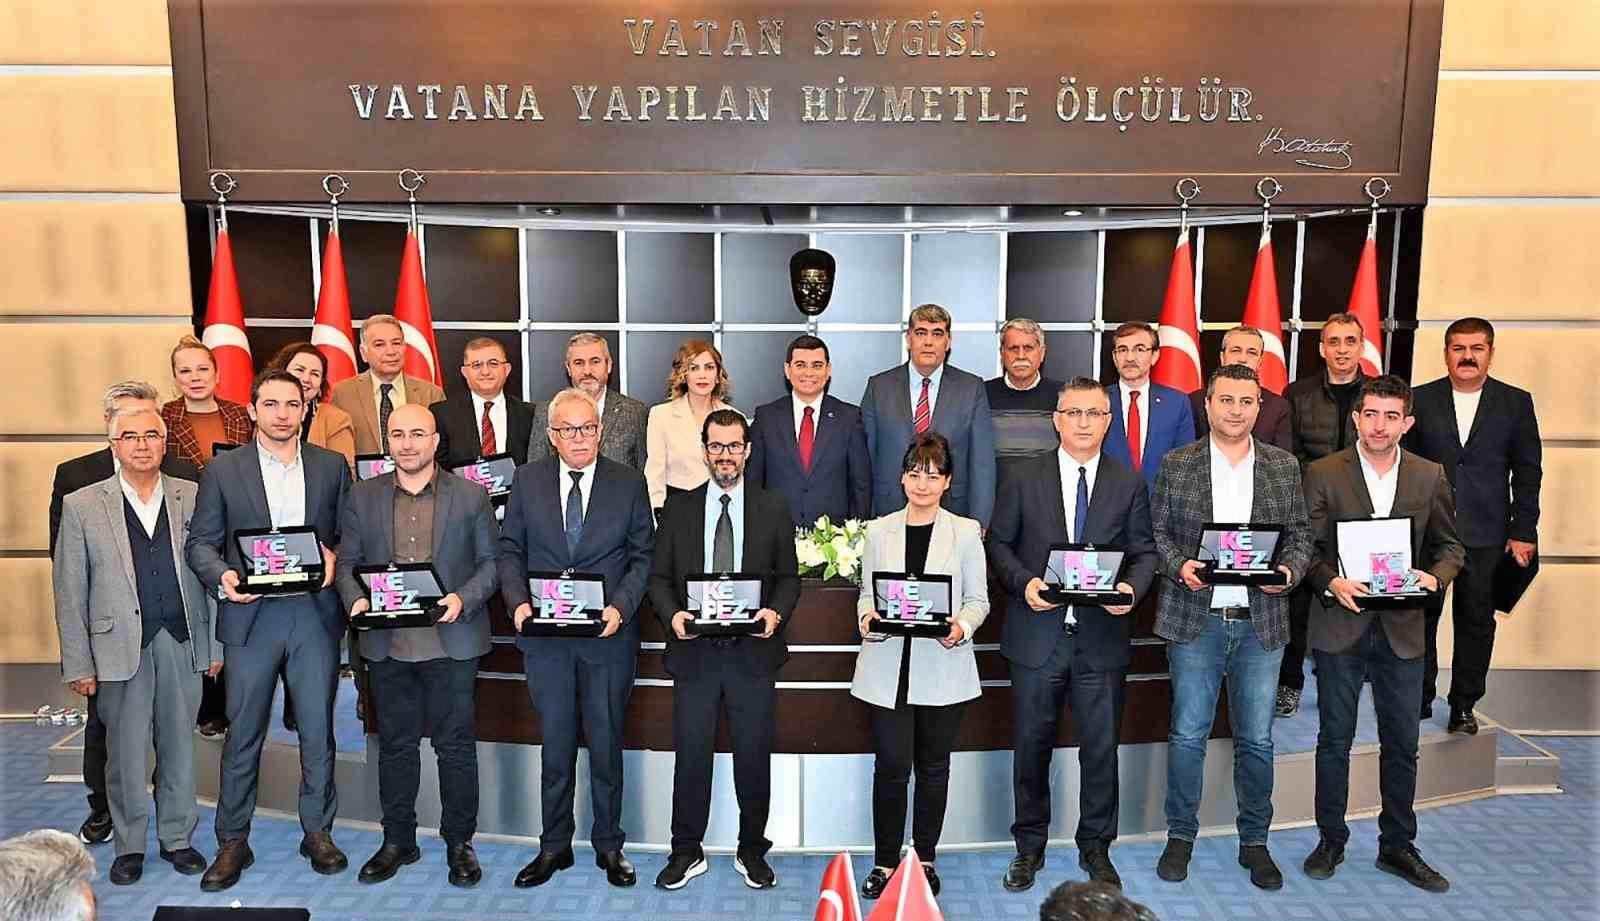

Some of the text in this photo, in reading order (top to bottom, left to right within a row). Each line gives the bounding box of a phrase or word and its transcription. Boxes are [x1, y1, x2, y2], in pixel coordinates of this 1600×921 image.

[623, 10, 997, 58] VATAN SEVGİSİ.
[348, 75, 1263, 132] VATANA YAPILAN HİZMETLE ÖLÇÜLÜR.
[254, 535, 286, 557] KE
[1222, 531, 1252, 550] KE
[253, 554, 301, 575] PEZ
[1218, 551, 1268, 569] PEZ
[370, 573, 404, 592] KE
[542, 579, 575, 599] KE
[887, 580, 919, 600] KE
[370, 590, 419, 612] PEZ
[540, 599, 588, 619] PEZ
[701, 599, 749, 620] PEZ
[887, 599, 933, 620] PEZ
